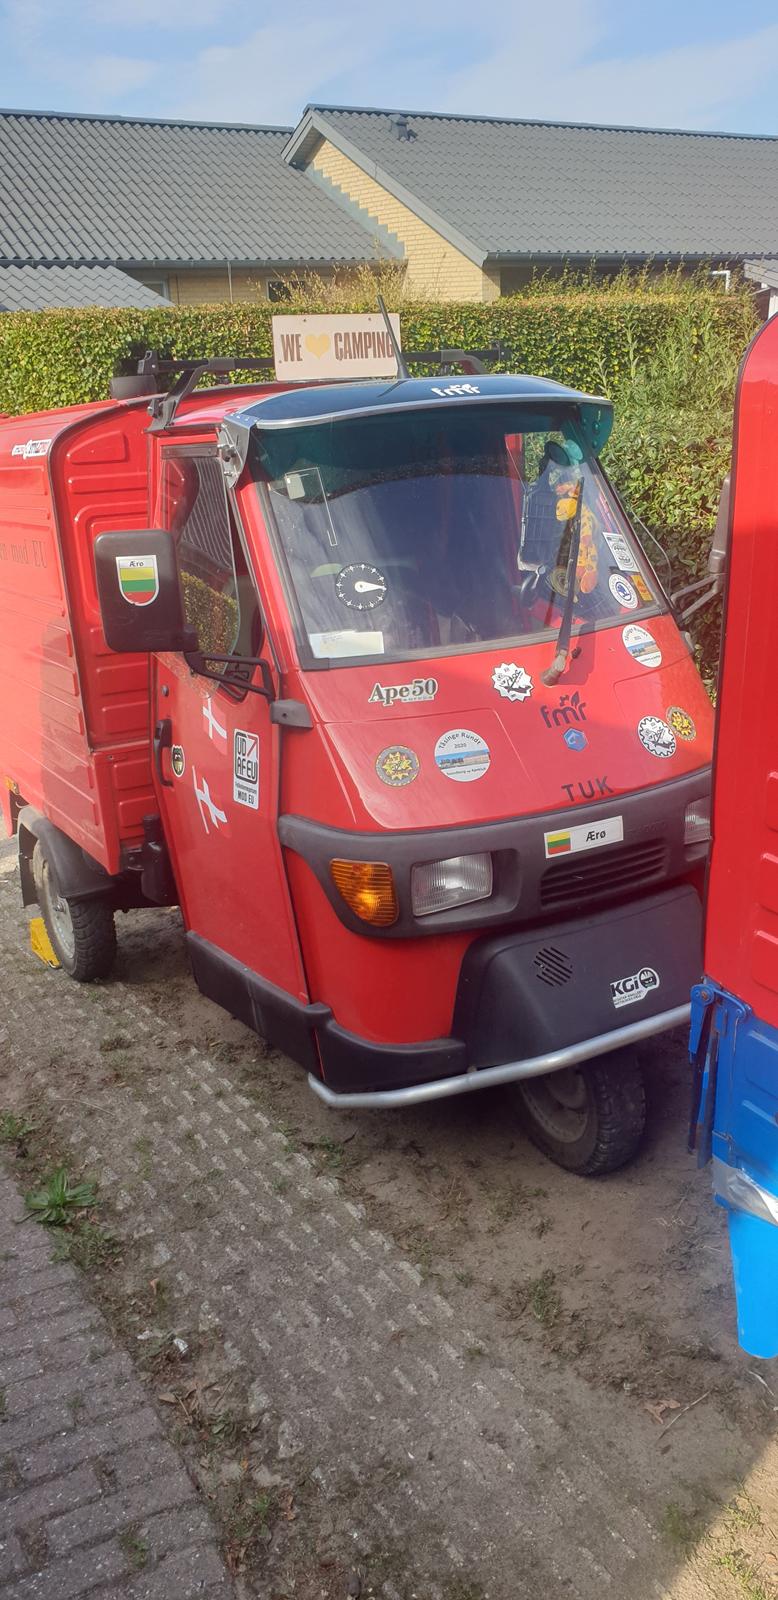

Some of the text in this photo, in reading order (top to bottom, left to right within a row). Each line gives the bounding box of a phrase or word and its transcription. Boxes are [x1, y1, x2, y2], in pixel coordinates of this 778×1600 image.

[280, 331, 396, 362] WE CAMPING
[368, 679, 438, 706] Ape 50
[236, 736, 247, 757] UD
[561, 776, 615, 802] TUK
[585, 829, 607, 842] Ærø
